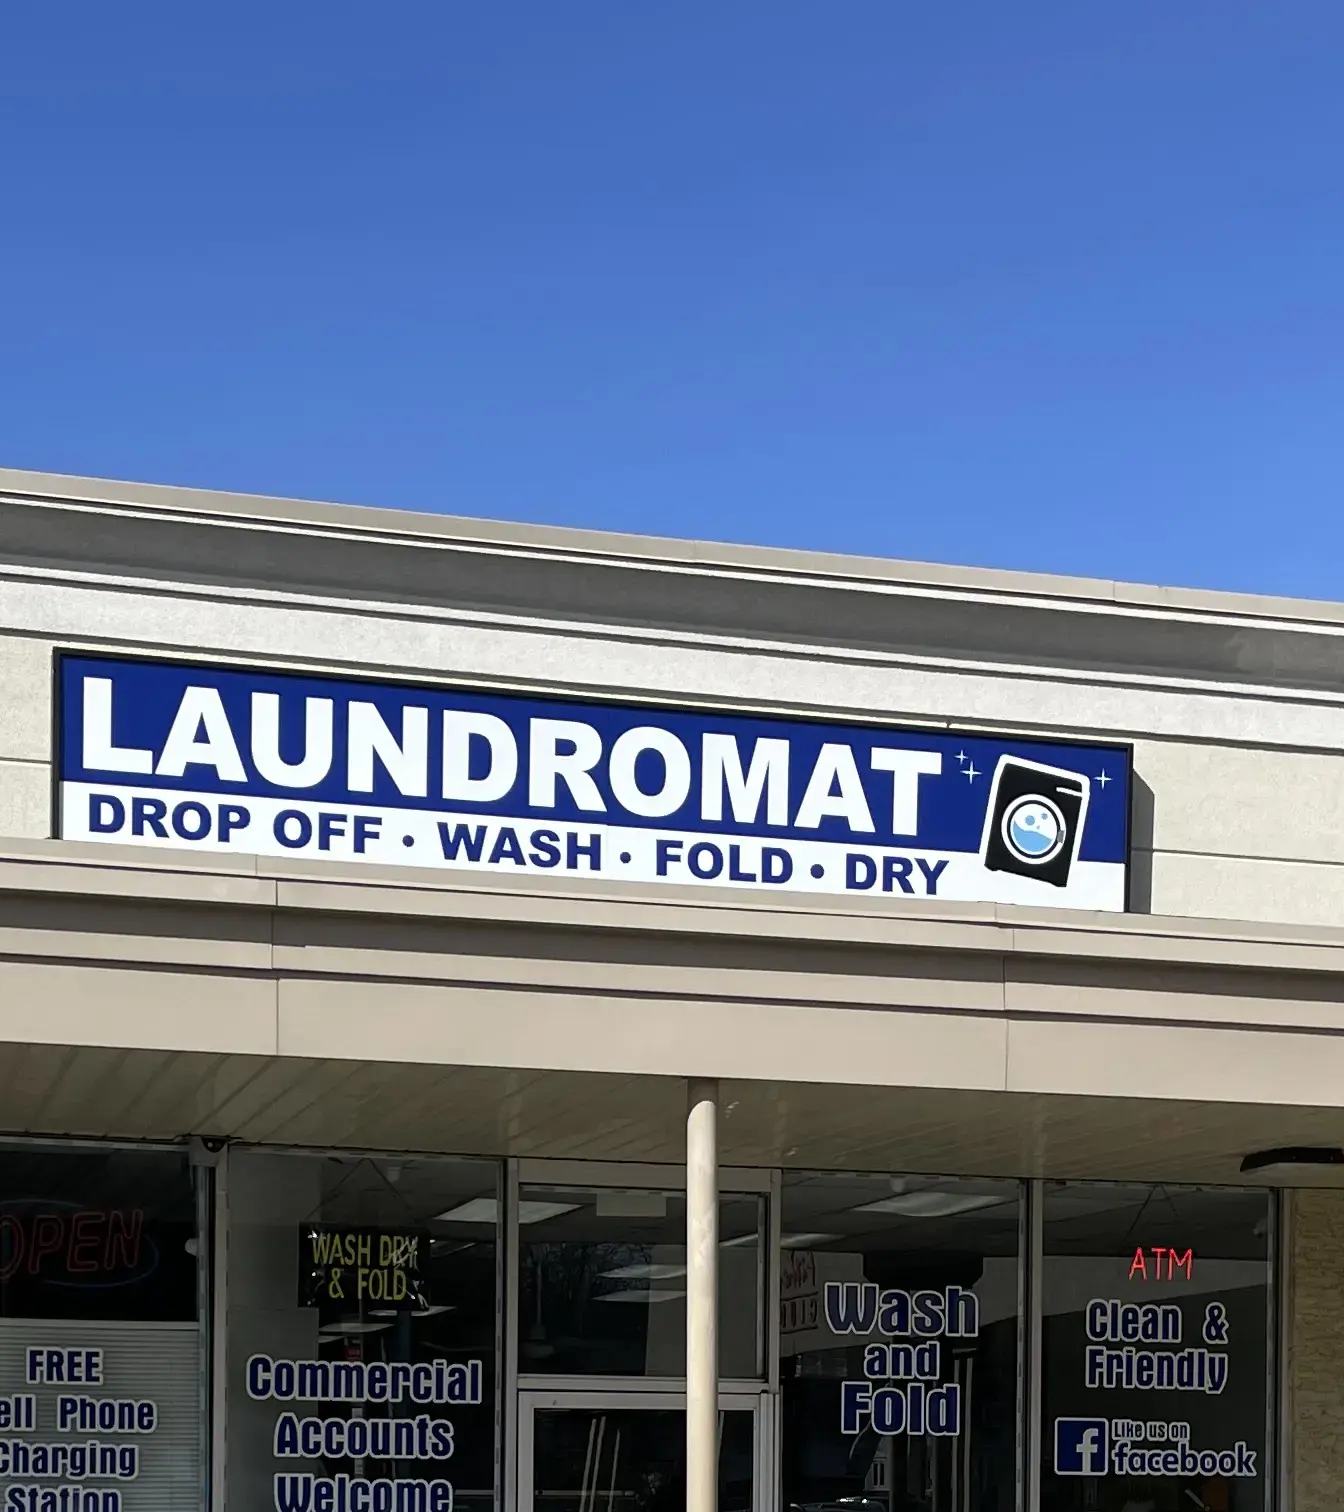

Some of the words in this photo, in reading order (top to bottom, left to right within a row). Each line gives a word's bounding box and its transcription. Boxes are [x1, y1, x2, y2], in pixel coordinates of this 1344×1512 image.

[81, 677, 943, 836] LAUNDROMAT
[88, 792, 252, 842] DROP
[272, 808, 382, 855] OFF
[436, 823, 603, 871] WASH
[655, 839, 792, 885] FOLD
[843, 855, 949, 896] DRY
[313, 1234, 370, 1264] WASH
[379, 1233, 419, 1268] DRY
[1129, 1247, 1194, 1280] ATM
[358, 1270, 407, 1301] FOLD
[824, 1282, 979, 1337] Wash
[1086, 1300, 1181, 1342] Clean
[1202, 1303, 1229, 1343] &
[27, 1348, 103, 1385] FREE
[247, 1354, 482, 1404] Commercial
[864, 1342, 939, 1378] and
[1086, 1347, 1228, 1394] Friendly
[58, 1395, 156, 1433] Phone
[841, 1382, 959, 1435] Fold
[273, 1413, 454, 1460] Accounts
[1112, 1420, 1145, 1441] Like
[1146, 1423, 1166, 1441] us
[1169, 1423, 1190, 1441] on
[1112, 1442, 1257, 1476] facebook
